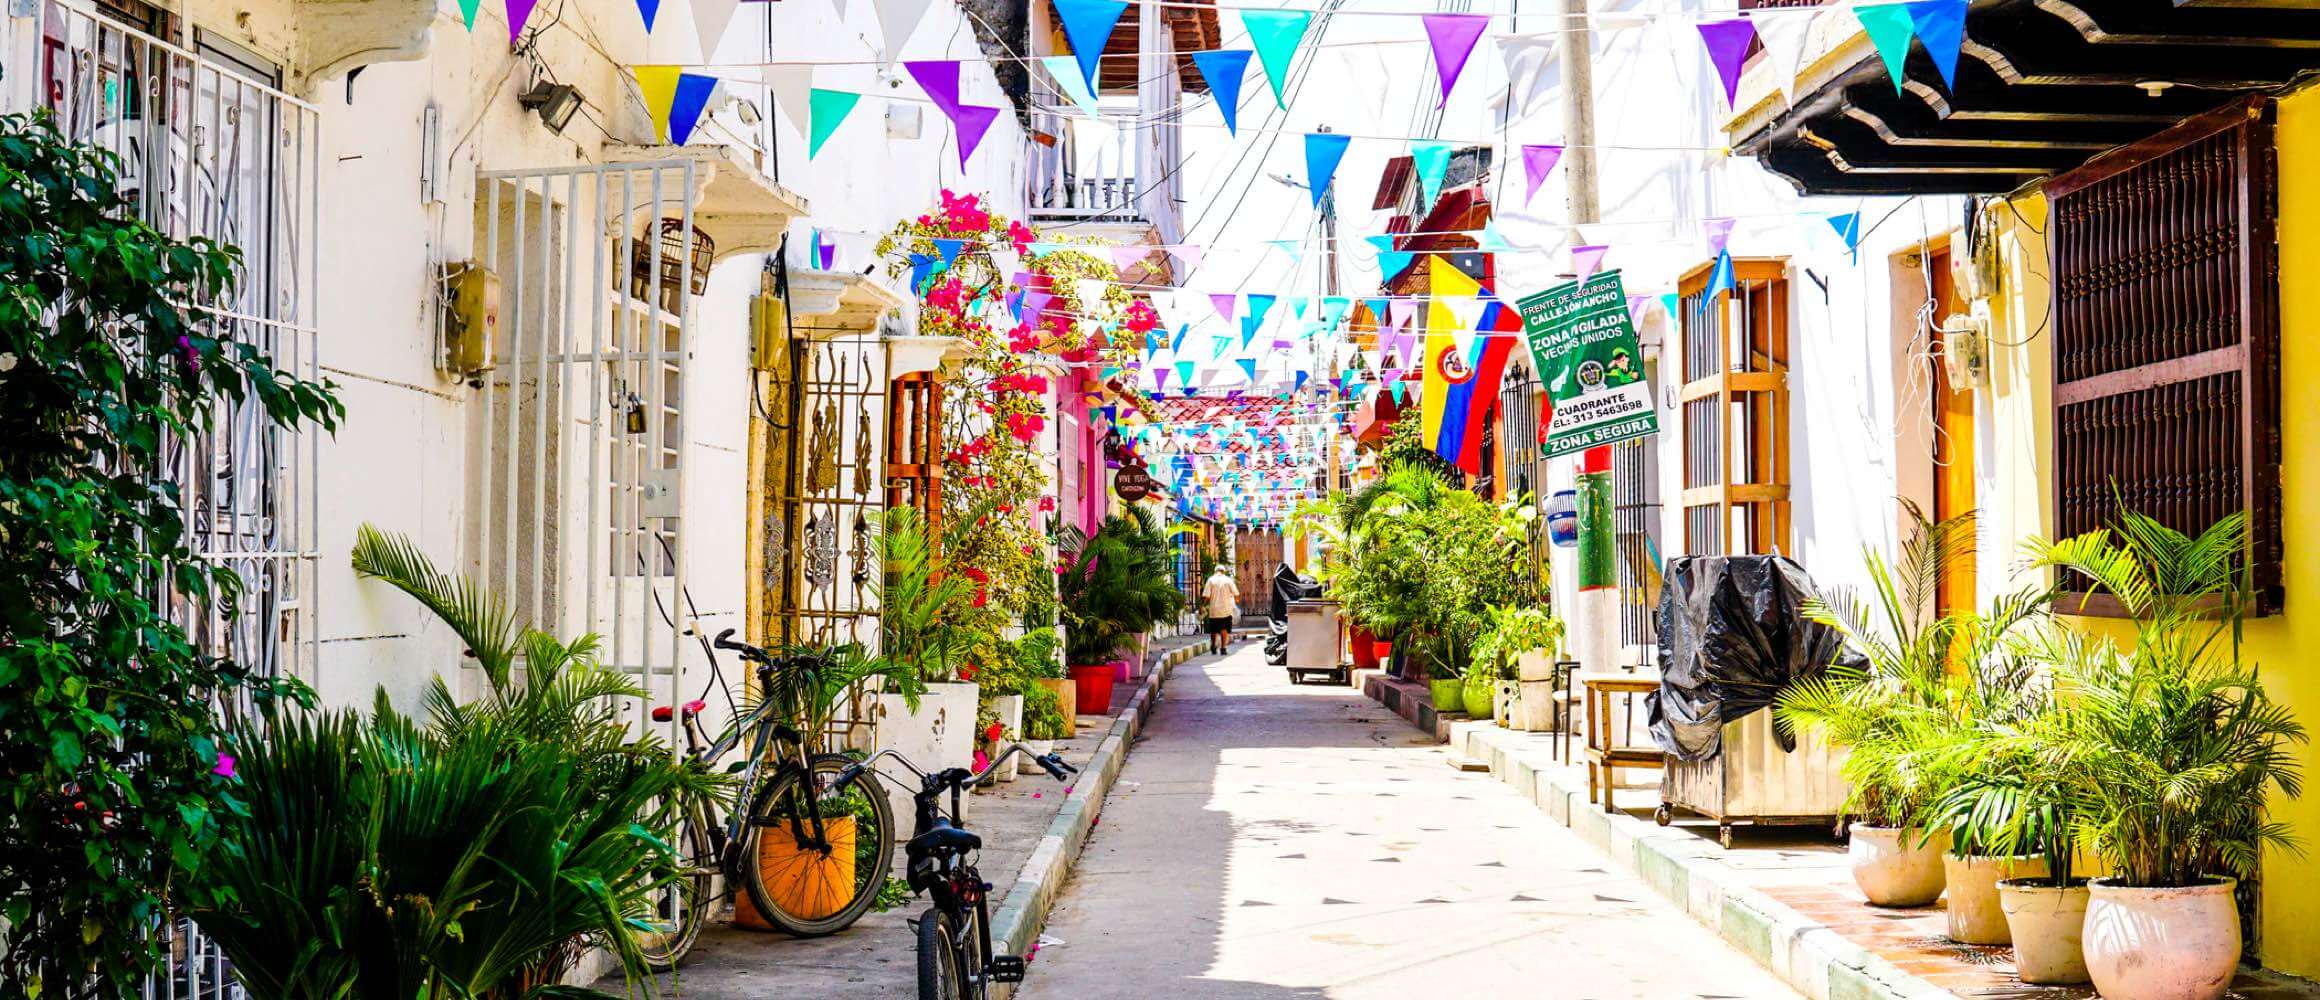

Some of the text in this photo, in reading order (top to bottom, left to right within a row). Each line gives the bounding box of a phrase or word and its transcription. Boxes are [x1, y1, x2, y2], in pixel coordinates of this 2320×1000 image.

[1523, 280, 1618, 315] FRENTE DE SEGURIDAD
[1582, 291, 1618, 309] ANCHO
[1533, 330, 1571, 351] ZONA
[1582, 327, 1623, 345] UNIDOS
[1557, 393, 1625, 417] CUADRANTE
[1573, 412, 1593, 424] 313
[1595, 400, 1643, 417] 5463698
[1550, 419, 1652, 453] ZONA SEGURA
